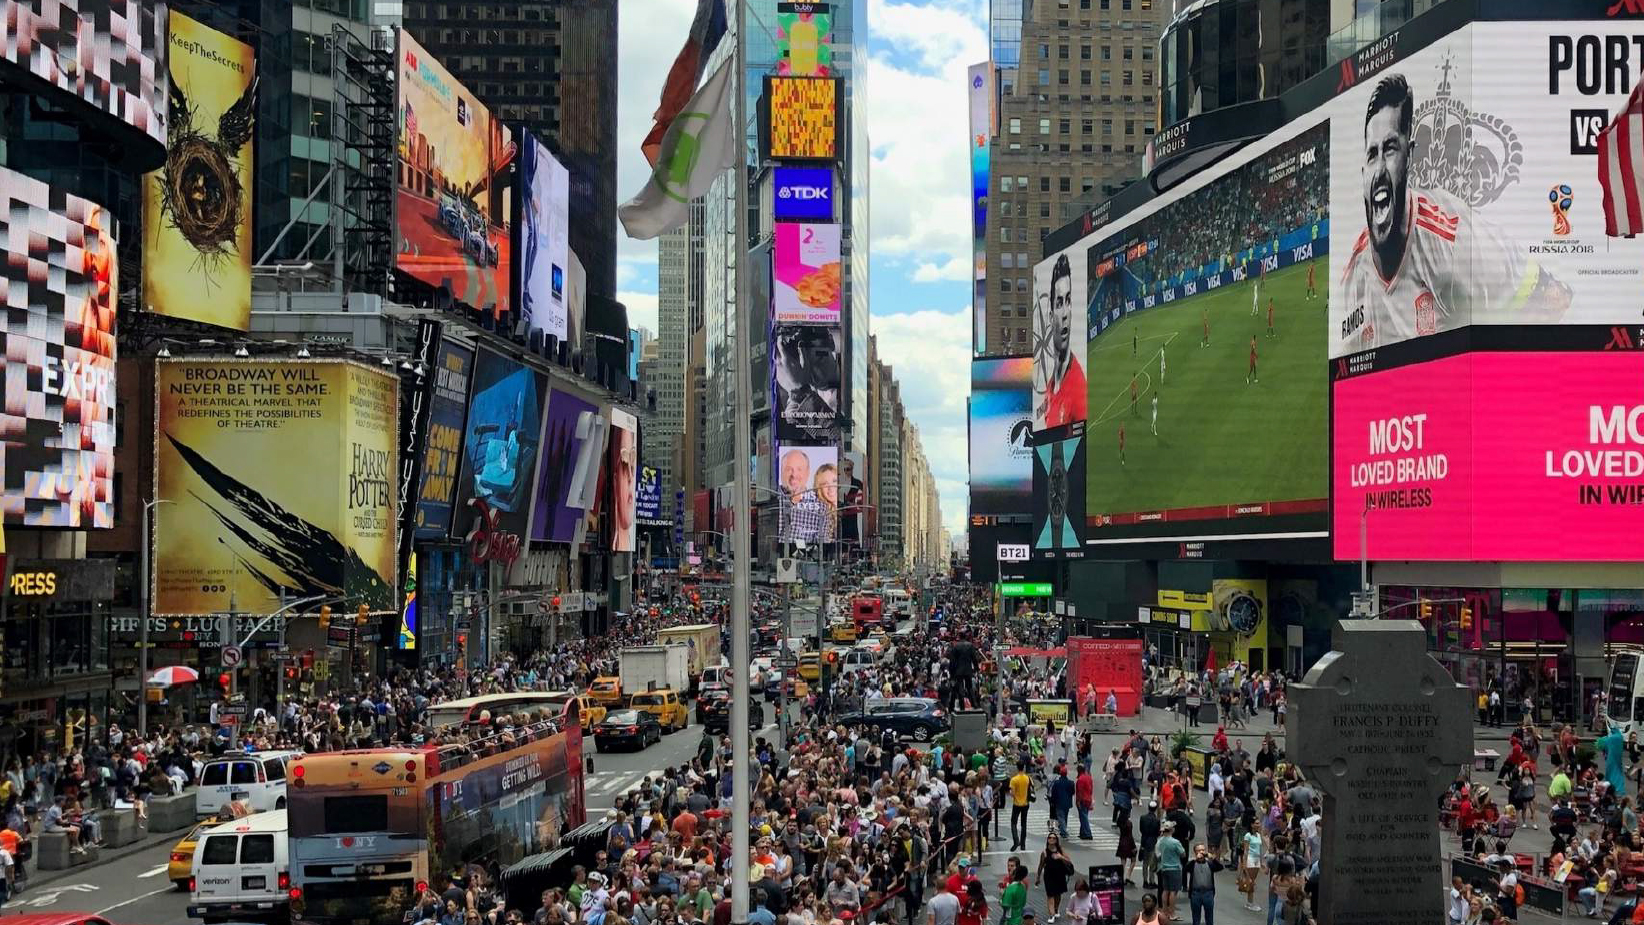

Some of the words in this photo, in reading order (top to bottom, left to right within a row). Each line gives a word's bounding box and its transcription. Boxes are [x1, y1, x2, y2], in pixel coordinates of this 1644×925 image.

[169, 33, 245, 74] KeepTheSecrets
[1358, 31, 1400, 63] MARRIOTT
[1358, 49, 1394, 78] MARQUIS
[1575, 116, 1603, 148] VS
[1300, 147, 1316, 169] FOX
[790, 187, 828, 199] TDK
[1092, 201, 1112, 216] MARRIOTT
[1092, 211, 1109, 226] MARQUIS
[803, 228, 814, 244] 2
[1529, 245, 1568, 254] RUSSIA
[1570, 245, 1594, 254] 2018
[1144, 295, 1156, 309] VISA
[1163, 288, 1175, 303] VISA
[1184, 281, 1197, 297] VISA
[1206, 273, 1221, 290] VISA
[1293, 243, 1314, 262] VISA
[1341, 305, 1365, 341] RAMOS
[1350, 352, 1376, 366] MARRIOTT
[179, 368, 276, 381] "BROADWAY
[281, 368, 320, 381] WILL
[1350, 362, 1374, 374] MARQUIS
[170, 383, 221, 395] NEVER
[227, 383, 247, 395] BE
[250, 383, 281, 395] THE
[286, 383, 331, 395] SAME.
[178, 398, 186, 407] A
[190, 398, 250, 407] THEATRICAL
[253, 398, 293, 407] MARVEL
[296, 398, 322, 407] THAT
[178, 409, 231, 418] REDEFINES
[235, 409, 253, 418] THE
[256, 409, 322, 418] POSSIBILITIES
[217, 419, 231, 428] OF
[235, 419, 286, 428] THEATRE."
[1369, 413, 1427, 455] MOST
[352, 443, 391, 480] HARRY
[1545, 450, 1644, 478] LOVED
[1351, 459, 1394, 488] LOVED
[1396, 453, 1448, 484] BRAND
[348, 474, 392, 510] POTTER
[1365, 491, 1376, 511] IN
[1378, 488, 1432, 510] WIRELESS
[1580, 485, 1602, 505] IN
[797, 502, 819, 511] EYES
[353, 516, 372, 530] CURSED
[373, 517, 388, 530] CHILD
[1000, 548, 1027, 558] BT21
[105, 617, 167, 633] GIFTS
[1333, 715, 1382, 727] FRANCIS
[1386, 715, 1394, 727] P
[1398, 715, 1441, 727] DUFFY
[1347, 744, 1389, 754] CATHOLIC
[1394, 744, 1427, 754] PRIEST
[502, 768, 527, 790] GETTING
[527, 763, 542, 780] WILD.
[453, 780, 463, 797] NY
[354, 836, 377, 848] NY
[202, 876, 231, 885] verizon
